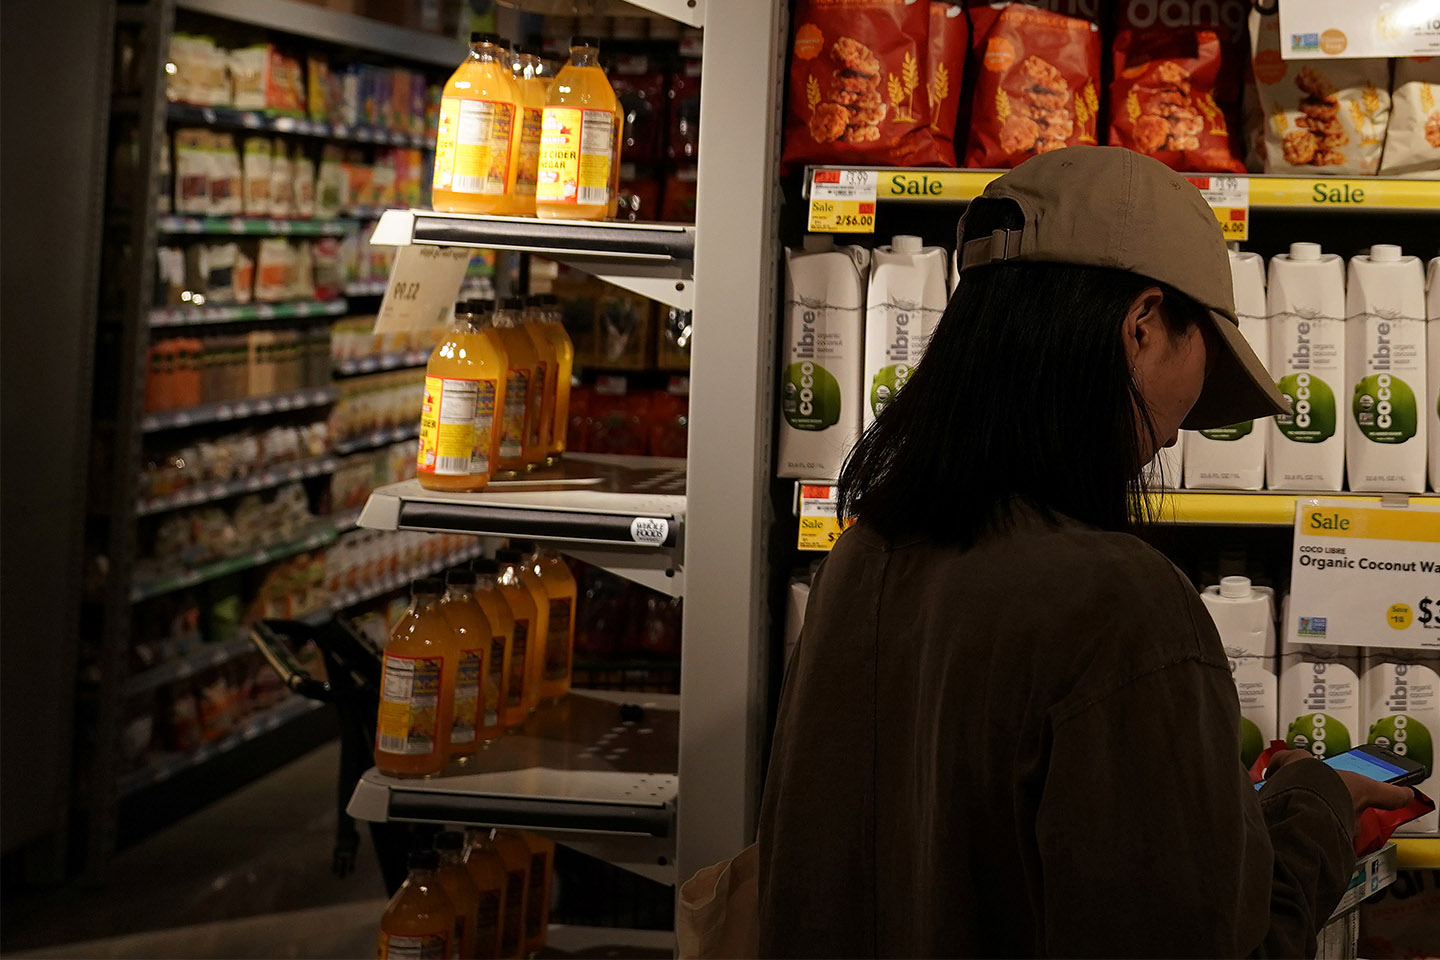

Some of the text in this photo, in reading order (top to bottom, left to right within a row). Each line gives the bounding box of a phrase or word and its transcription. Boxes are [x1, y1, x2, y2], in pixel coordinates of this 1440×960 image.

[891, 175, 943, 196] Sale
[1313, 182, 1365, 204] Sale
[813, 202, 834, 213] Sale
[836, 214, 873, 226] 2/$6.00
[886, 313, 909, 361] libre
[793, 311, 816, 416] libre coco
[1288, 322, 1311, 428] libre coco
[1368, 322, 1392, 429] libre coco
[801, 518, 824, 530] Sale
[1310, 512, 1351, 532] Sale
[636, 529, 663, 538] FOODS
[1299, 545, 1346, 555] COCO LIBRE
[1299, 555, 1355, 570] Organic
[1358, 558, 1416, 573] Coconut
[1304, 662, 1326, 760] libre oco
[1385, 663, 1408, 757] libre oco
